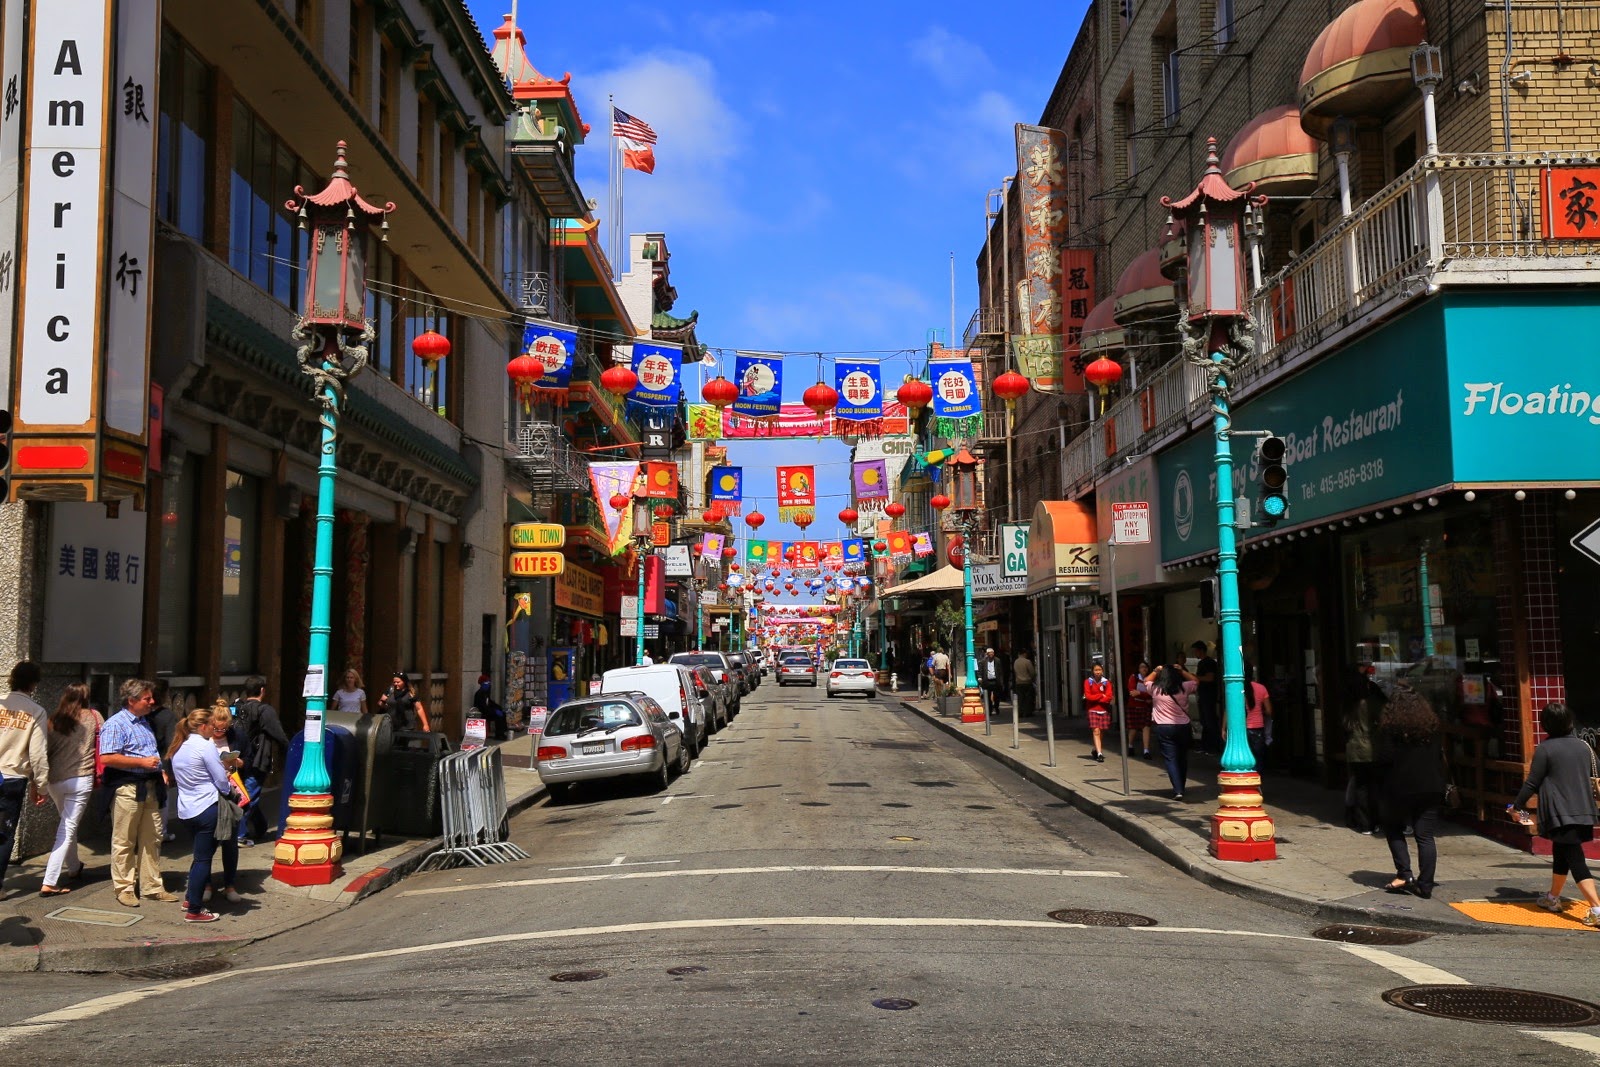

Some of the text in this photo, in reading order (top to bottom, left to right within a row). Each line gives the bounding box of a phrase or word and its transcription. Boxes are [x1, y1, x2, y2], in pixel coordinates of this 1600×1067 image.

[45, 39, 86, 395] America
[644, 359, 668, 373] 年年
[847, 376, 869, 388] 生意
[943, 376, 964, 388] 花好
[636, 391, 672, 402] PROSPERITY
[847, 388, 870, 400] 興隆
[944, 388, 966, 399] 月圓
[752, 403, 778, 412] FESTIVAL
[943, 404, 972, 413] CELEBRATE
[1285, 428, 1319, 465] Boat
[1322, 389, 1404, 453] Restaurant
[1301, 458, 1384, 500] Tel: 415-956-8318
[1114, 511, 1123, 520] NO
[513, 530, 560, 544] CHINA TOWN
[59, 544, 140, 585] 美國銀行
[514, 557, 558, 572] KITES
[973, 573, 995, 585] WOK
